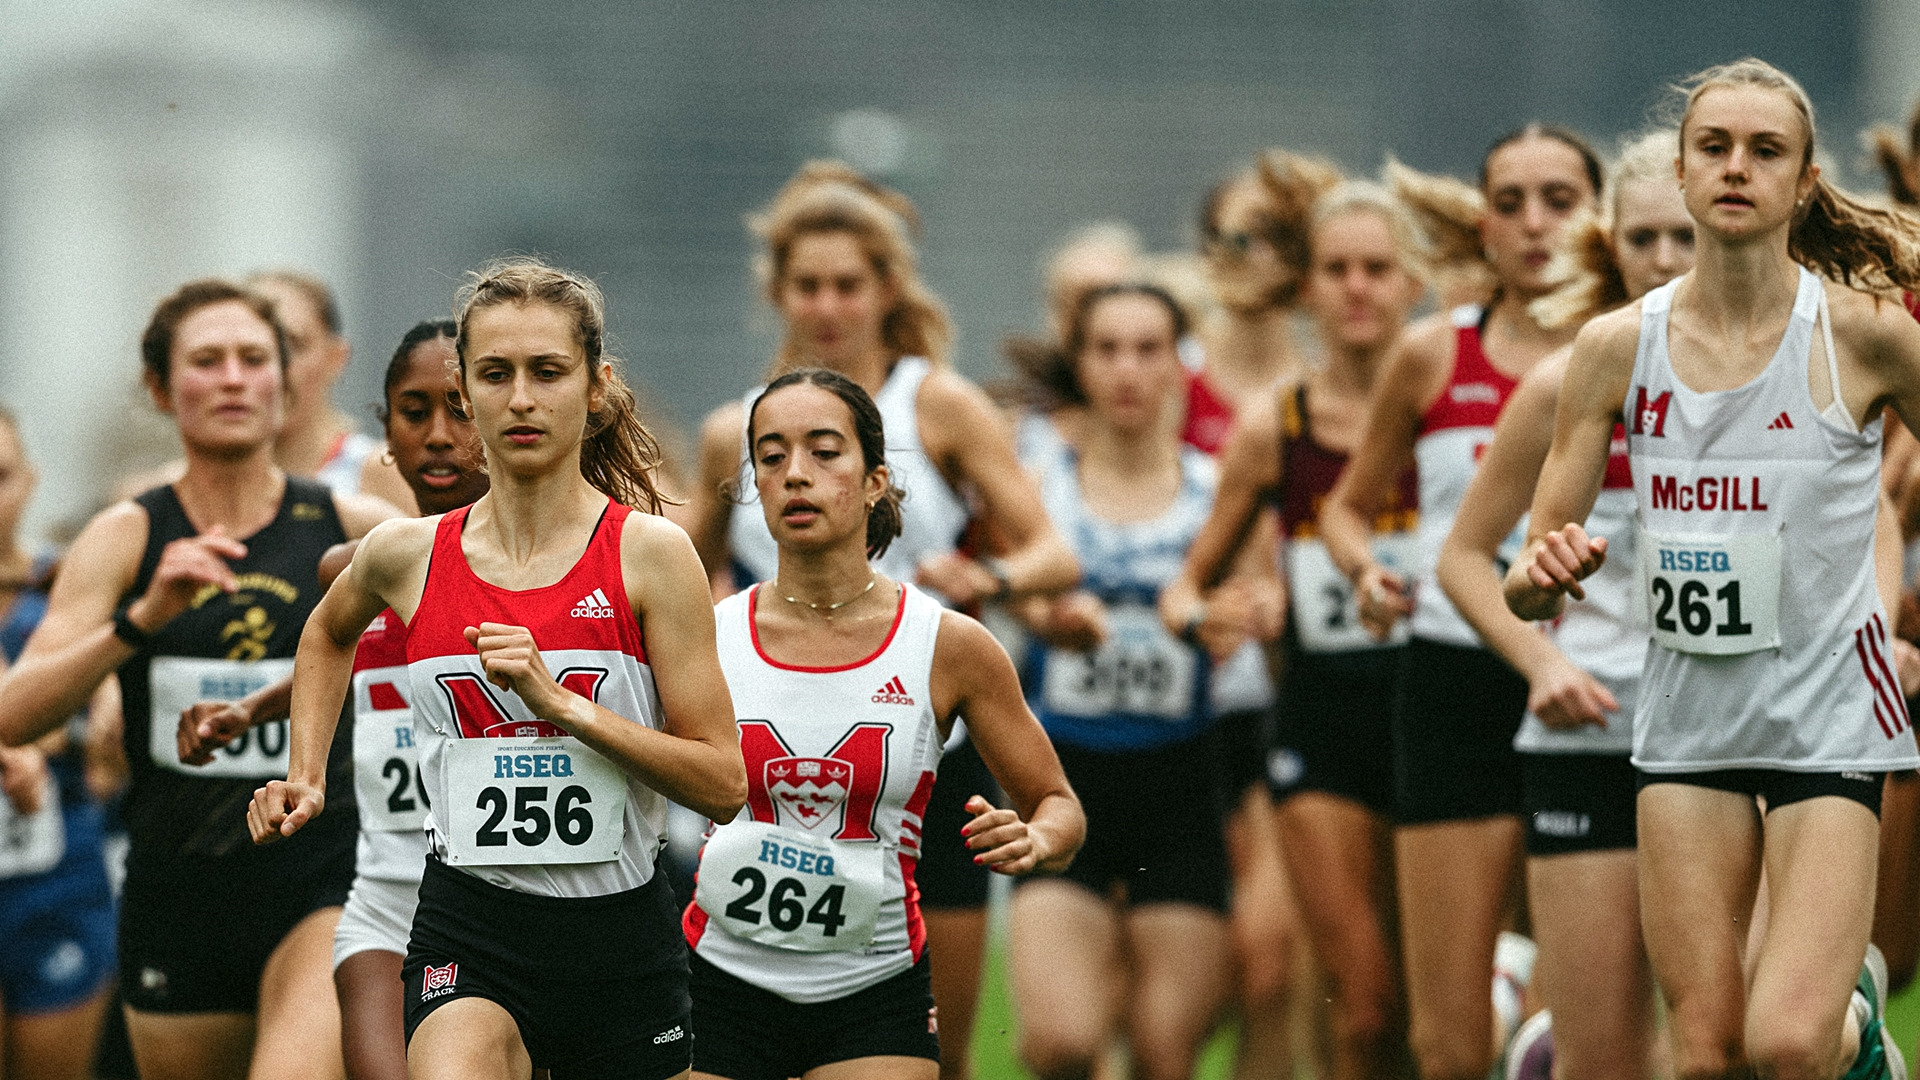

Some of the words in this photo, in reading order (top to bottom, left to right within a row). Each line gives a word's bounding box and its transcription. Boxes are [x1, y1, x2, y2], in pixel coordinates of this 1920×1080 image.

[1651, 474, 1768, 512] McGILL
[1658, 549, 1731, 572] RSEQ
[1651, 576, 1752, 636] 261
[871, 694, 914, 706] adidas
[494, 754, 575, 778] RSEQ
[475, 784, 594, 847] 256
[757, 840, 835, 877] RSEQ
[725, 866, 846, 937] 264
[421, 987, 456, 1002] TRACK
[653, 1030, 684, 1045] adidas
